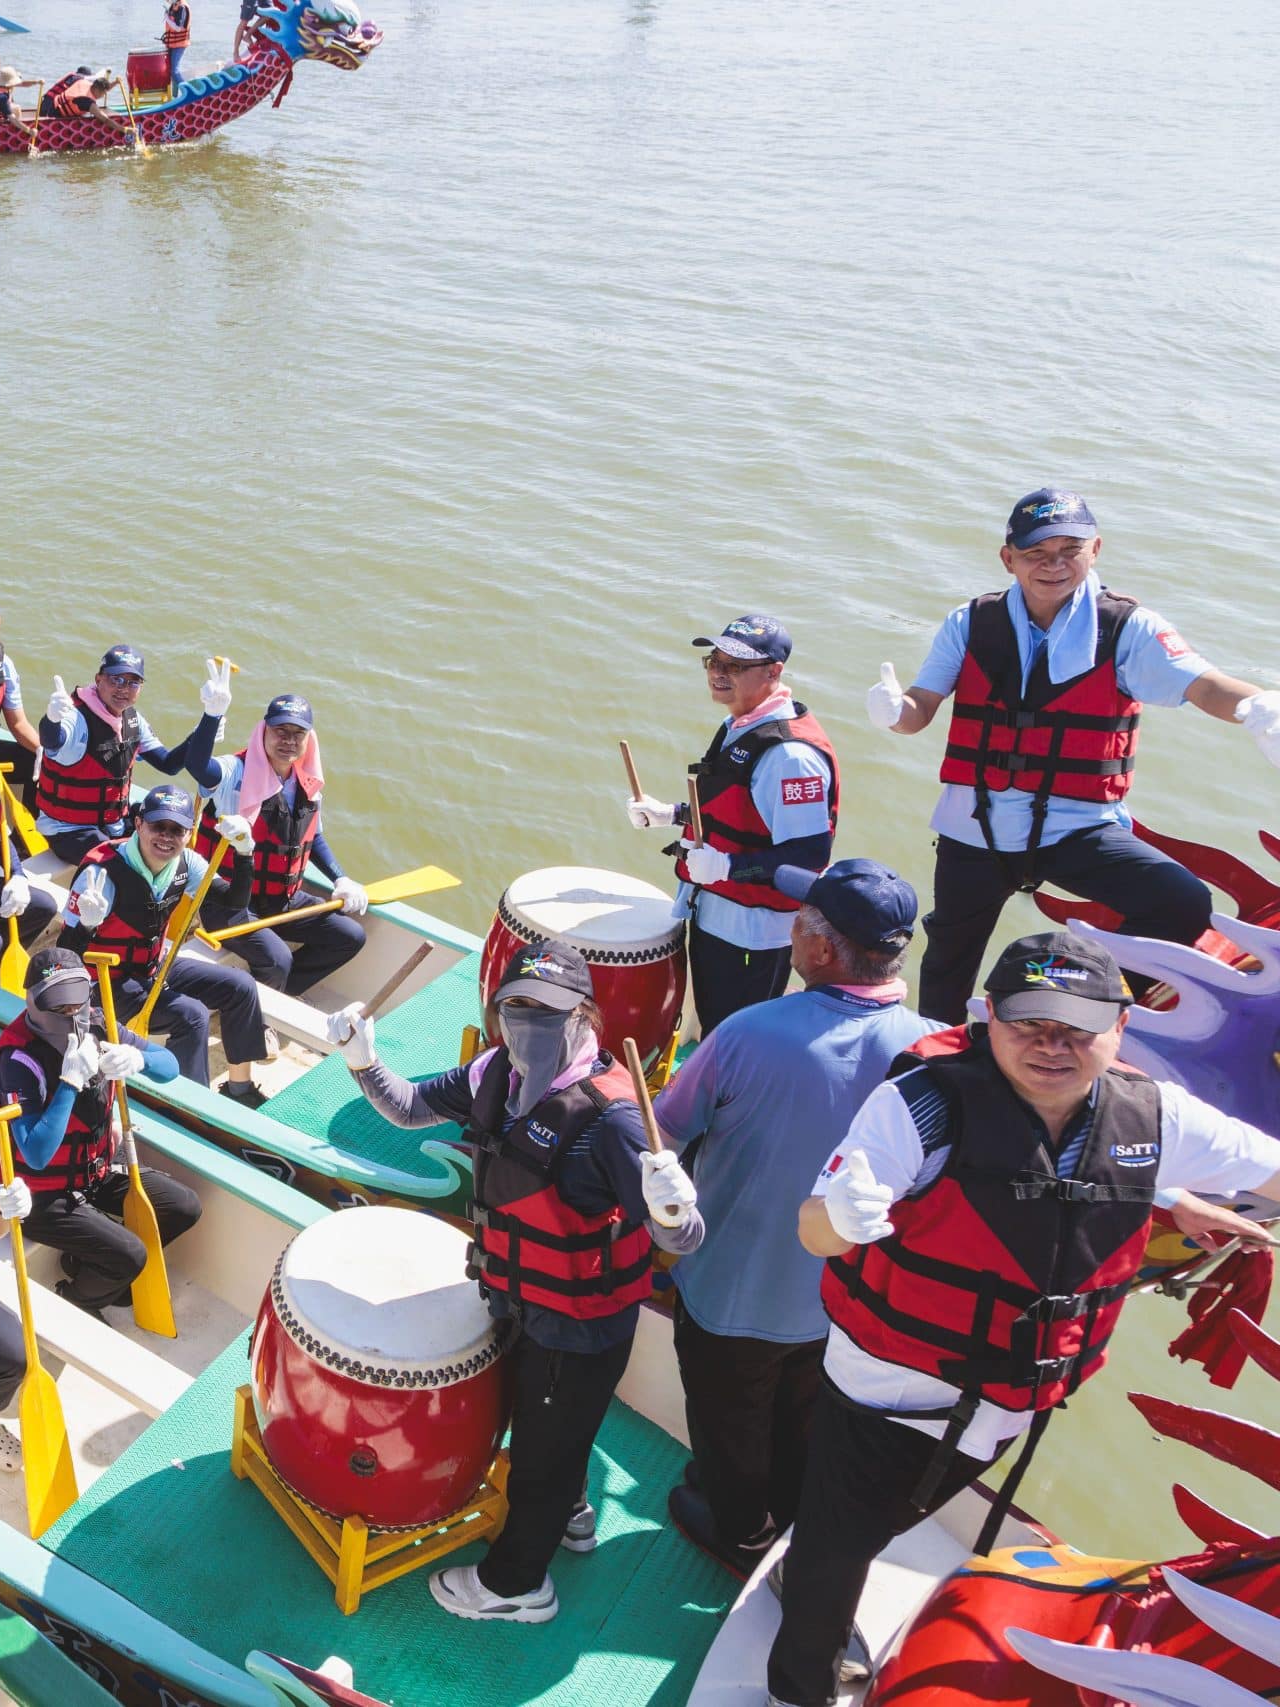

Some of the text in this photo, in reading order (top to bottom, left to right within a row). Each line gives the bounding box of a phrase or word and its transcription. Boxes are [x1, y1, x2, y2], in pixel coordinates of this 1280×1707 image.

[784, 780, 821, 801] 鼓手
[531, 1121, 555, 1140] S&TT
[1116, 1143, 1152, 1157] S&TT
